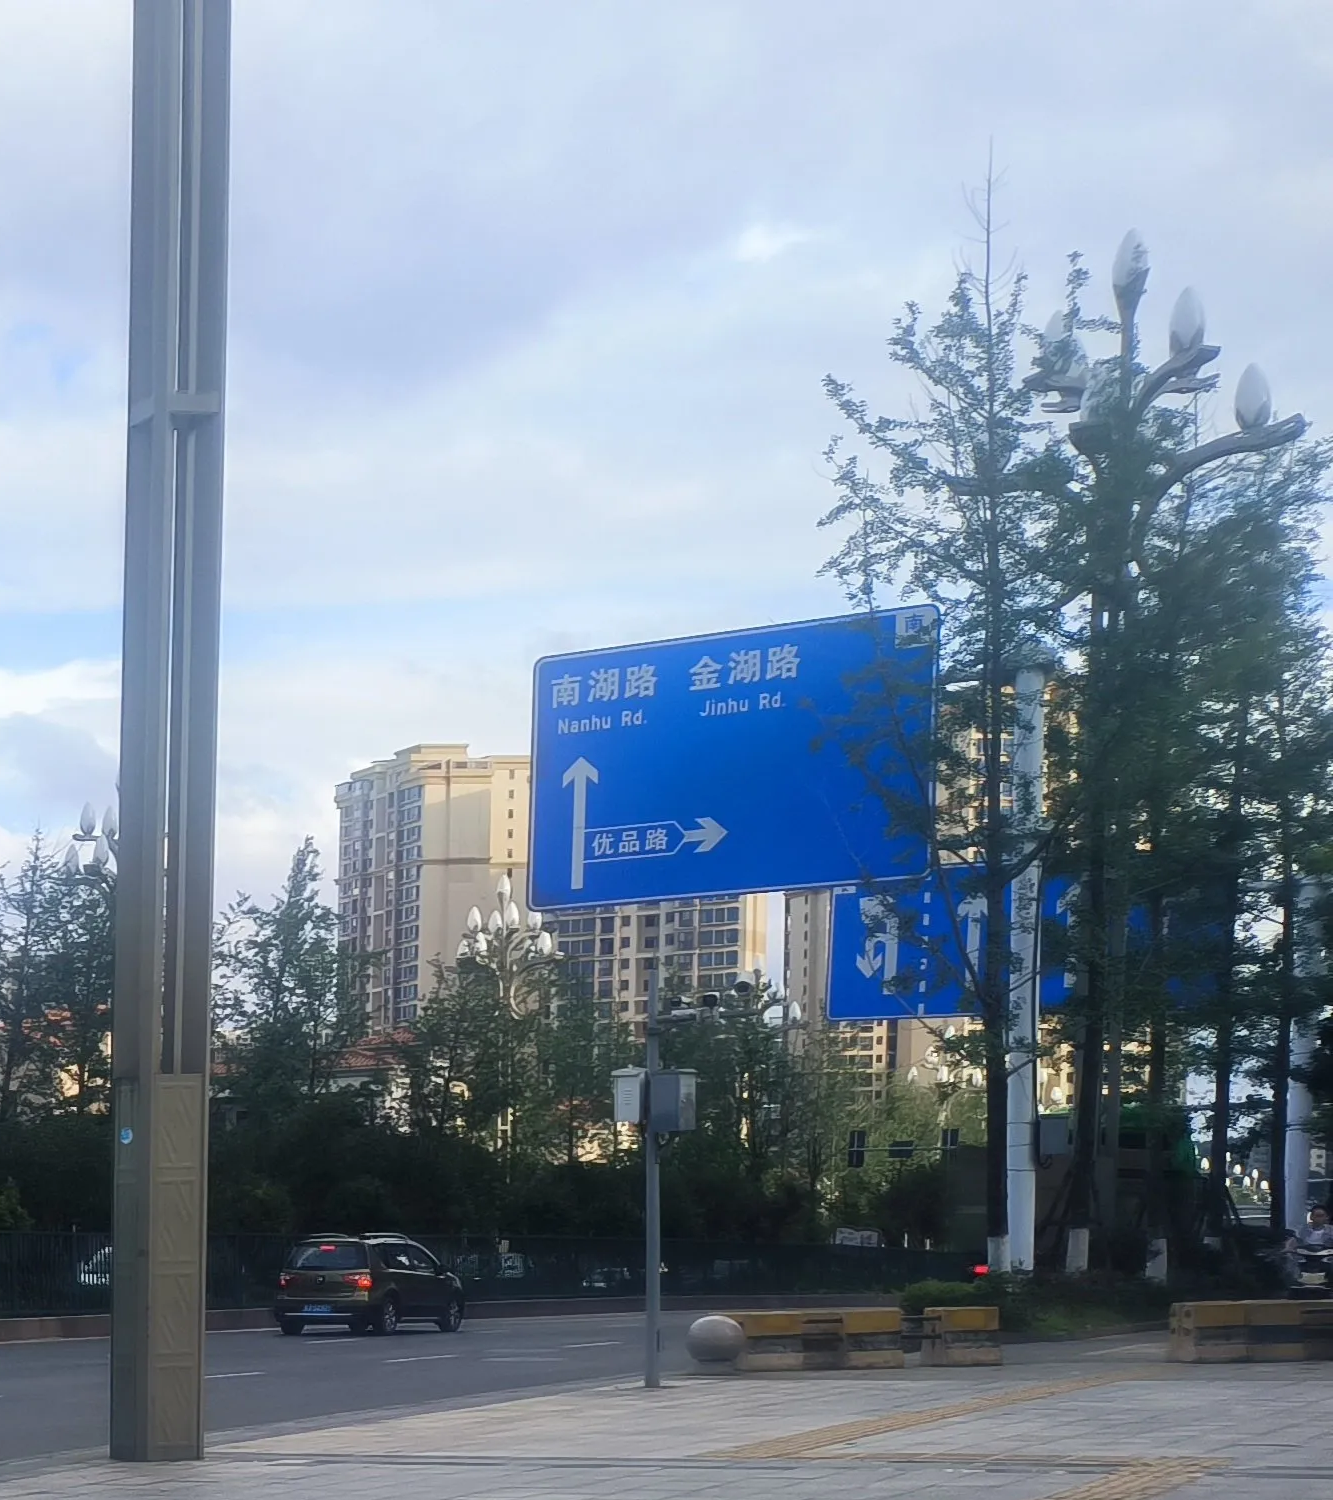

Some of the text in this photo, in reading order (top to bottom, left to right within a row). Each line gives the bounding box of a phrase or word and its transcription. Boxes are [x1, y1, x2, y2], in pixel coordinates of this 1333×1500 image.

[550, 643, 801, 709] 南湖路 金湖路
[557, 714, 611, 735] Nanhu
[699, 697, 749, 717] Jinhu
[591, 827, 668, 857] 优品路
